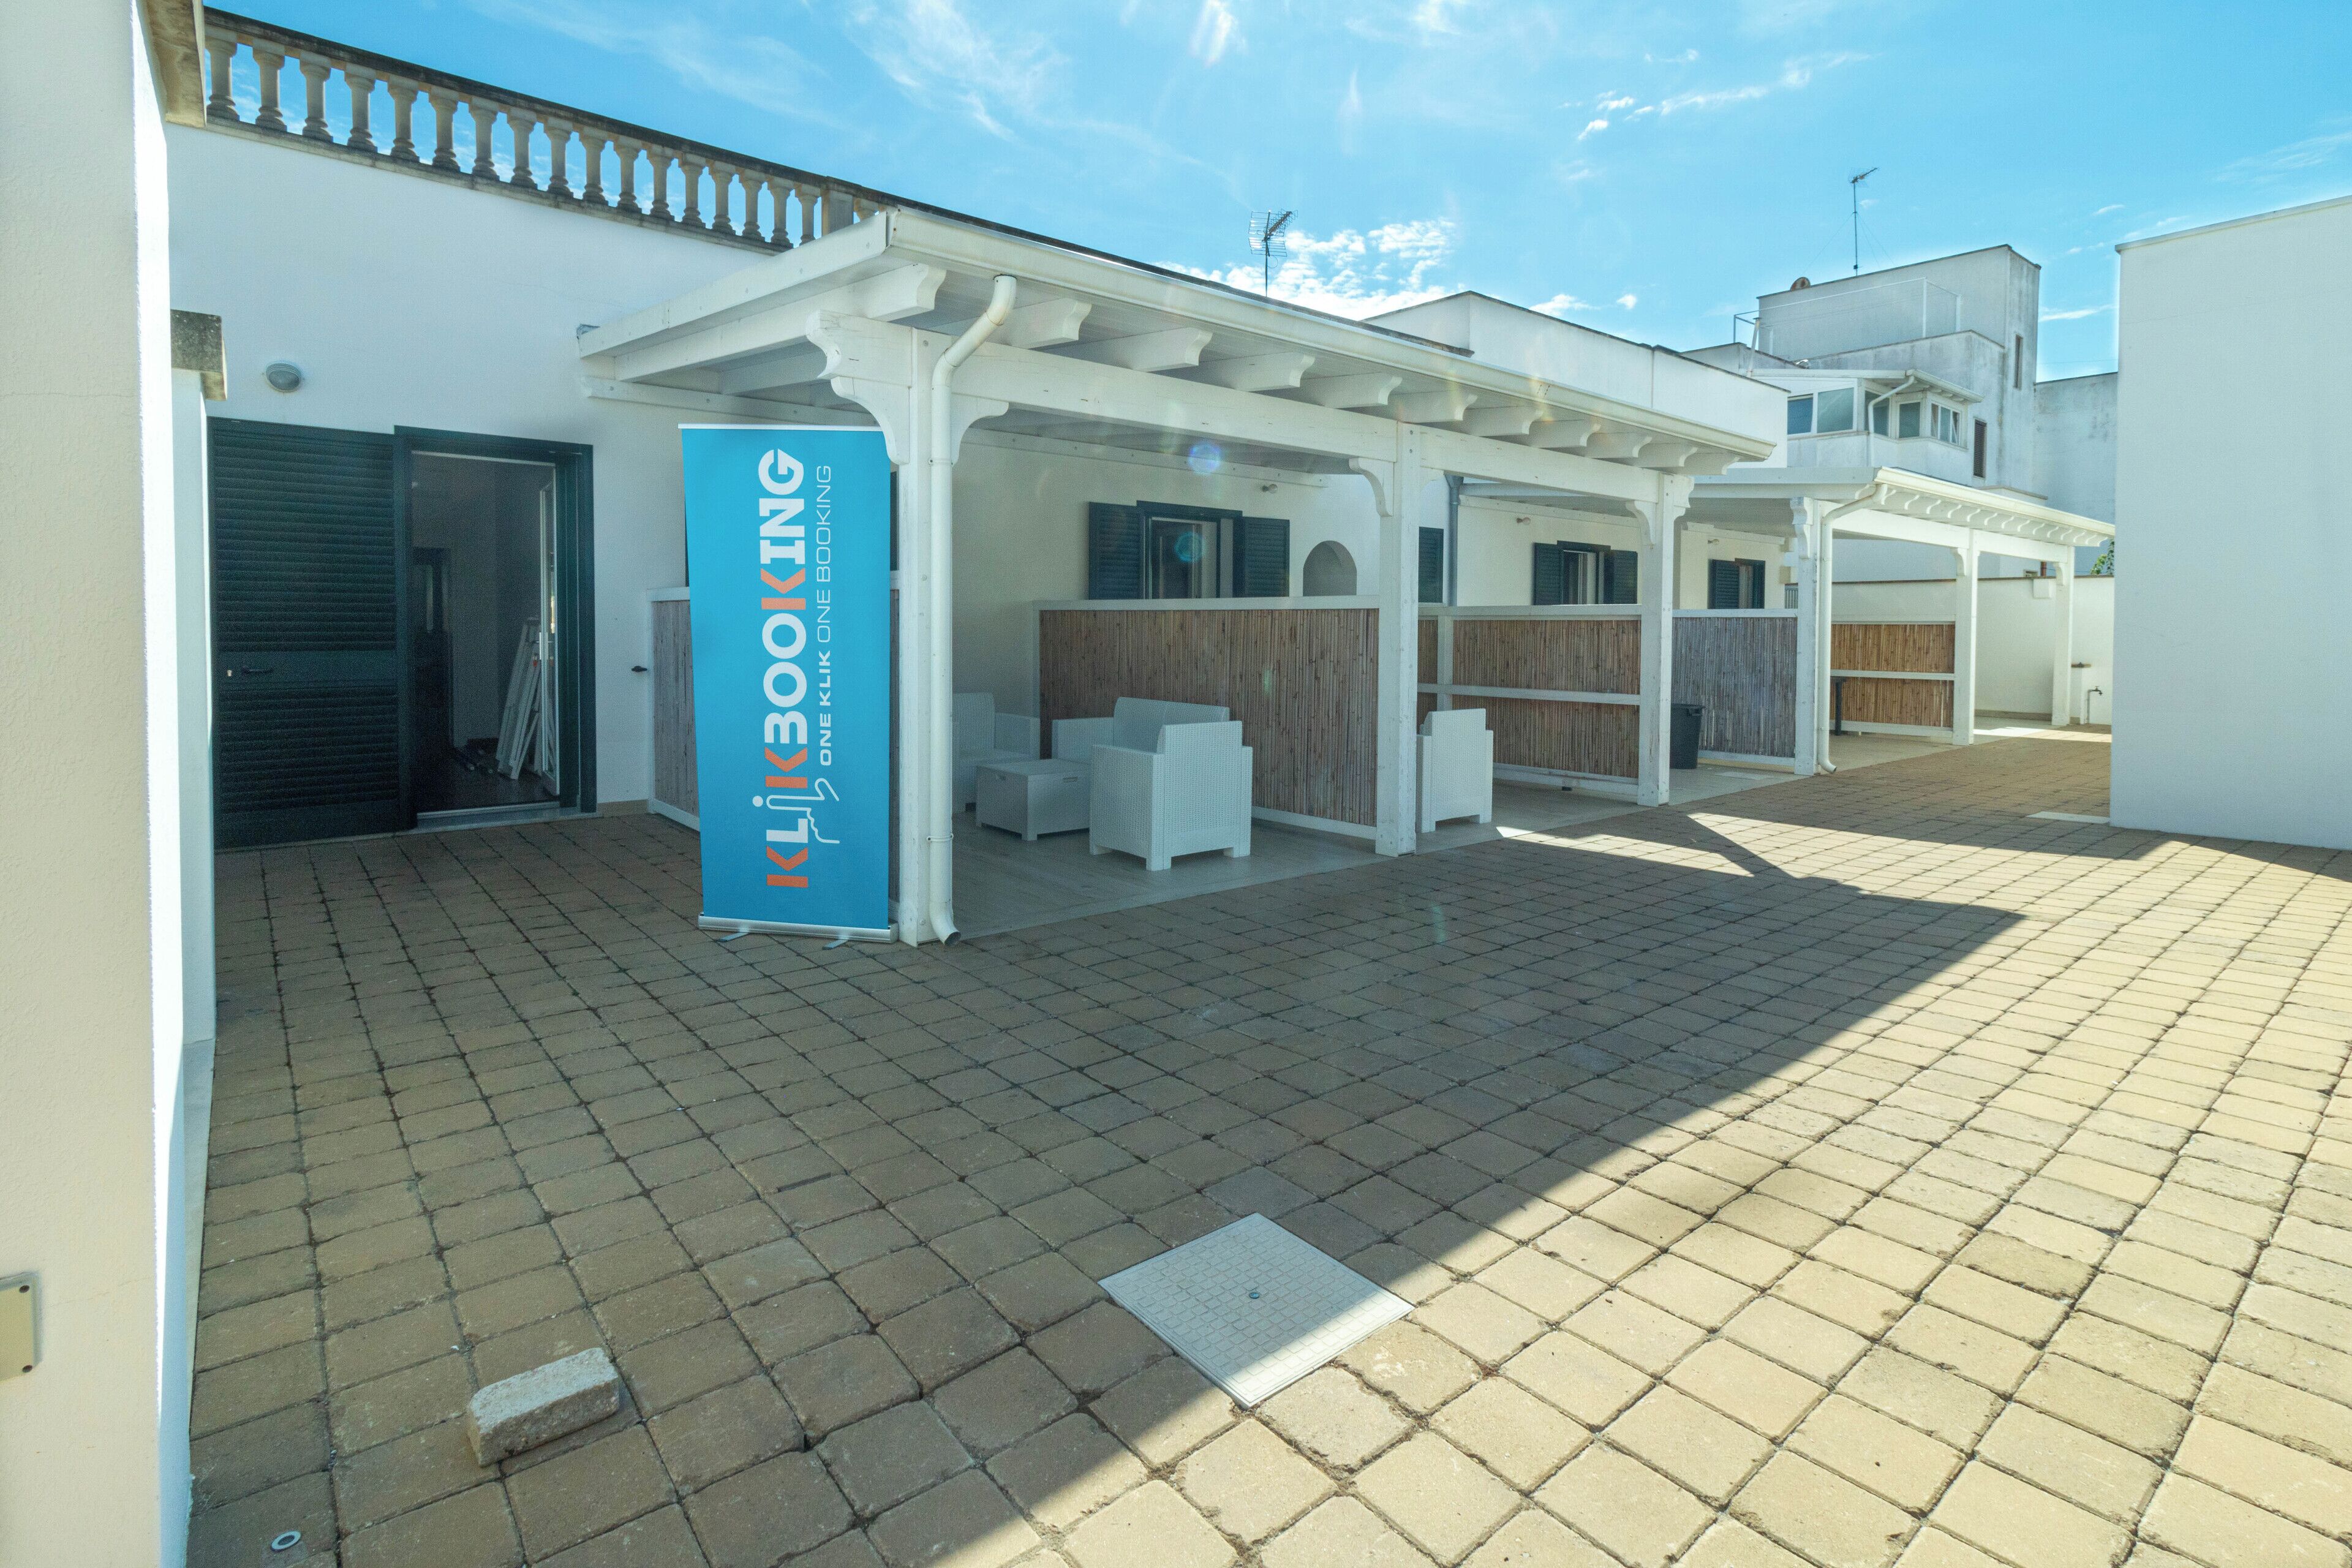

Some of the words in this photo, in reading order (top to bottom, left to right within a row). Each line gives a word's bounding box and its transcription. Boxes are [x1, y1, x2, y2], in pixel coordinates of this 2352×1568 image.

[816, 464, 832, 582] BOOKING
[817, 589, 831, 643] ONE
[818, 650, 832, 707] KLIK
[819, 713, 832, 767] ONE
